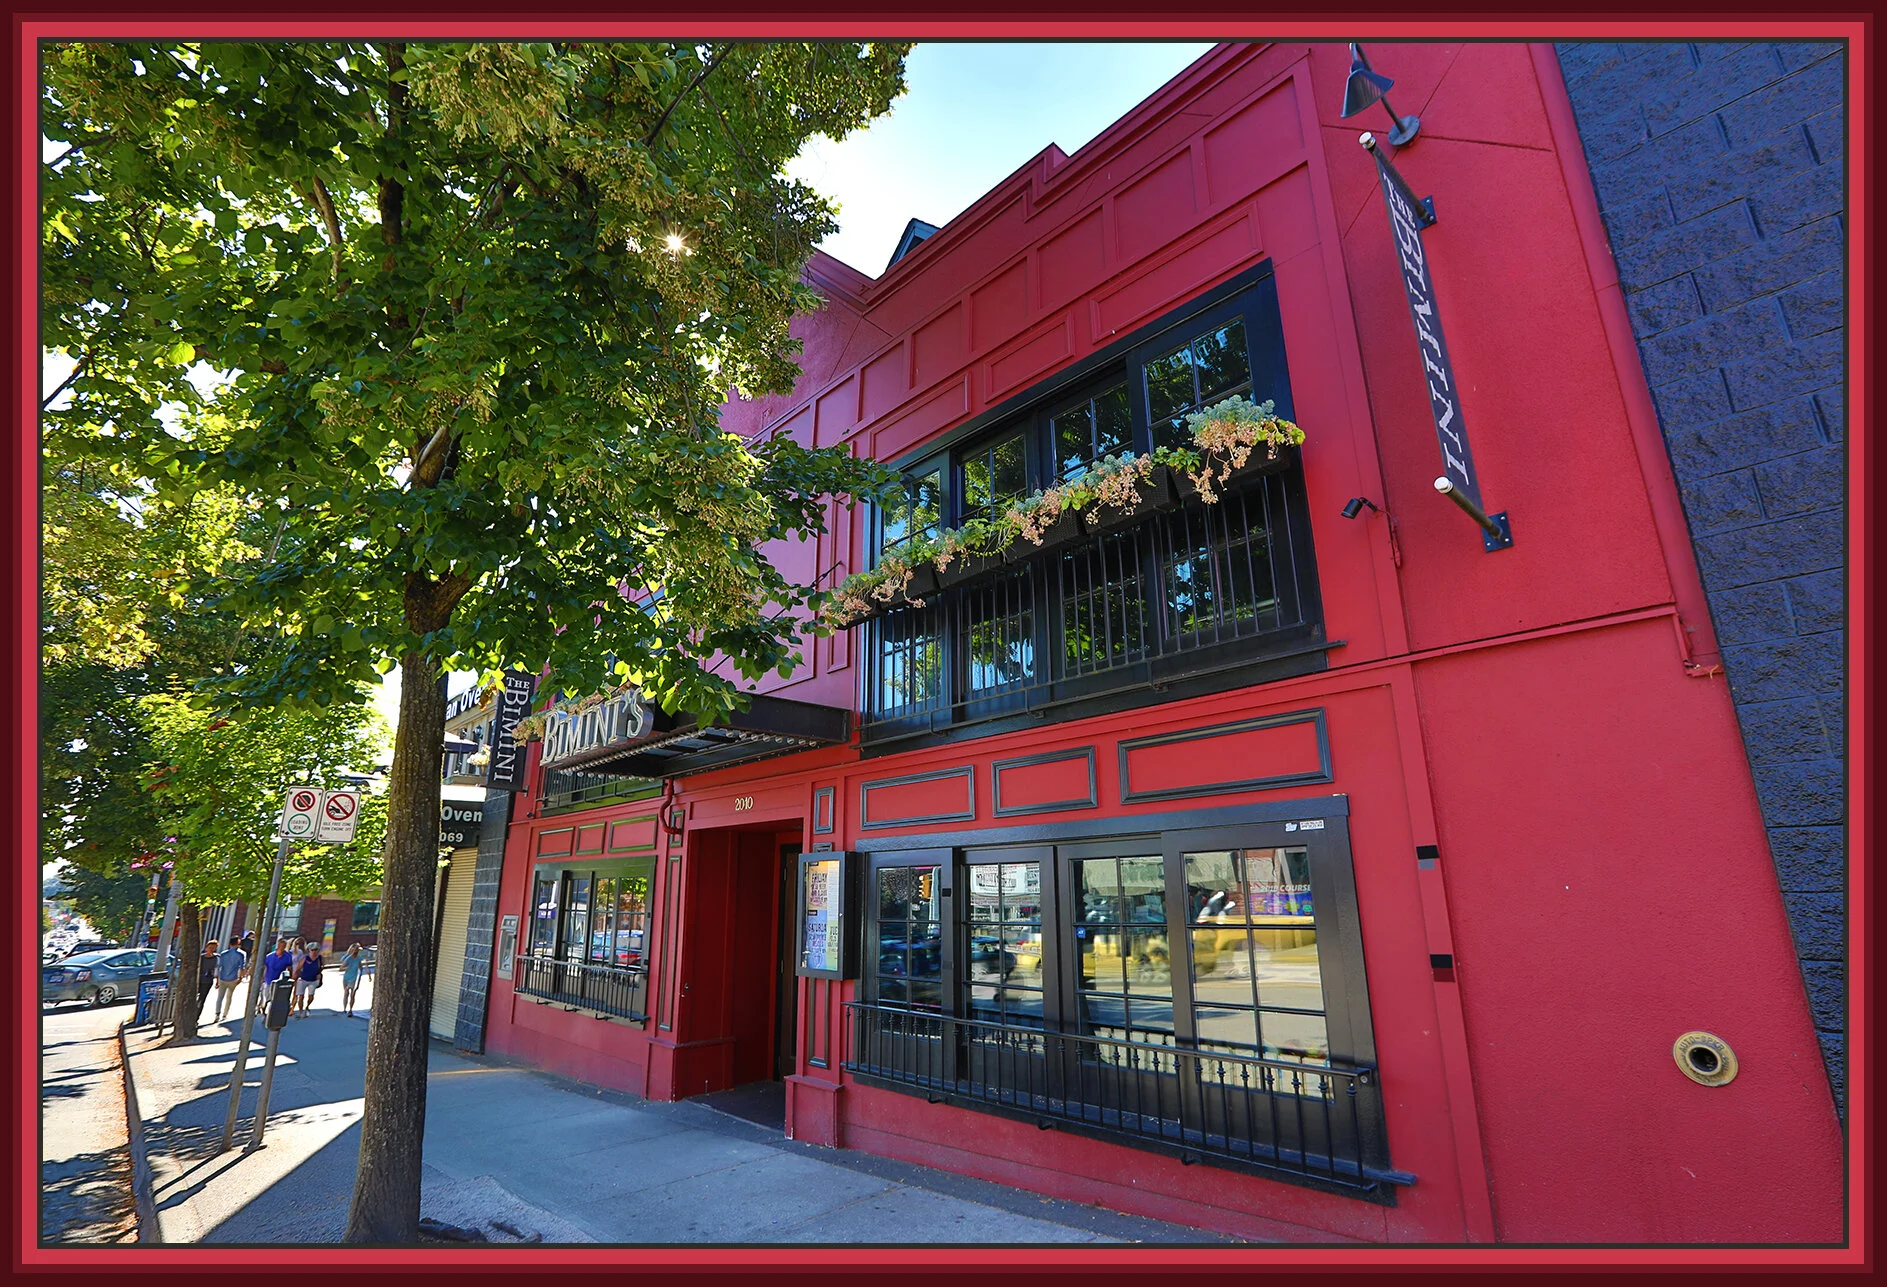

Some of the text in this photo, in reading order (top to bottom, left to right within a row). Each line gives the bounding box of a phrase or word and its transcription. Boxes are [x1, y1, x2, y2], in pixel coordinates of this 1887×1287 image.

[1383, 172, 1416, 228] THE
[1389, 198, 1469, 486] BIMINI
[506, 677, 531, 690] THE
[494, 687, 529, 783] BIMINI
[540, 688, 646, 766] BIMINI'S
[441, 805, 484, 823] Oven
[735, 796, 754, 811] 2010
[440, 832, 464, 843] 069
